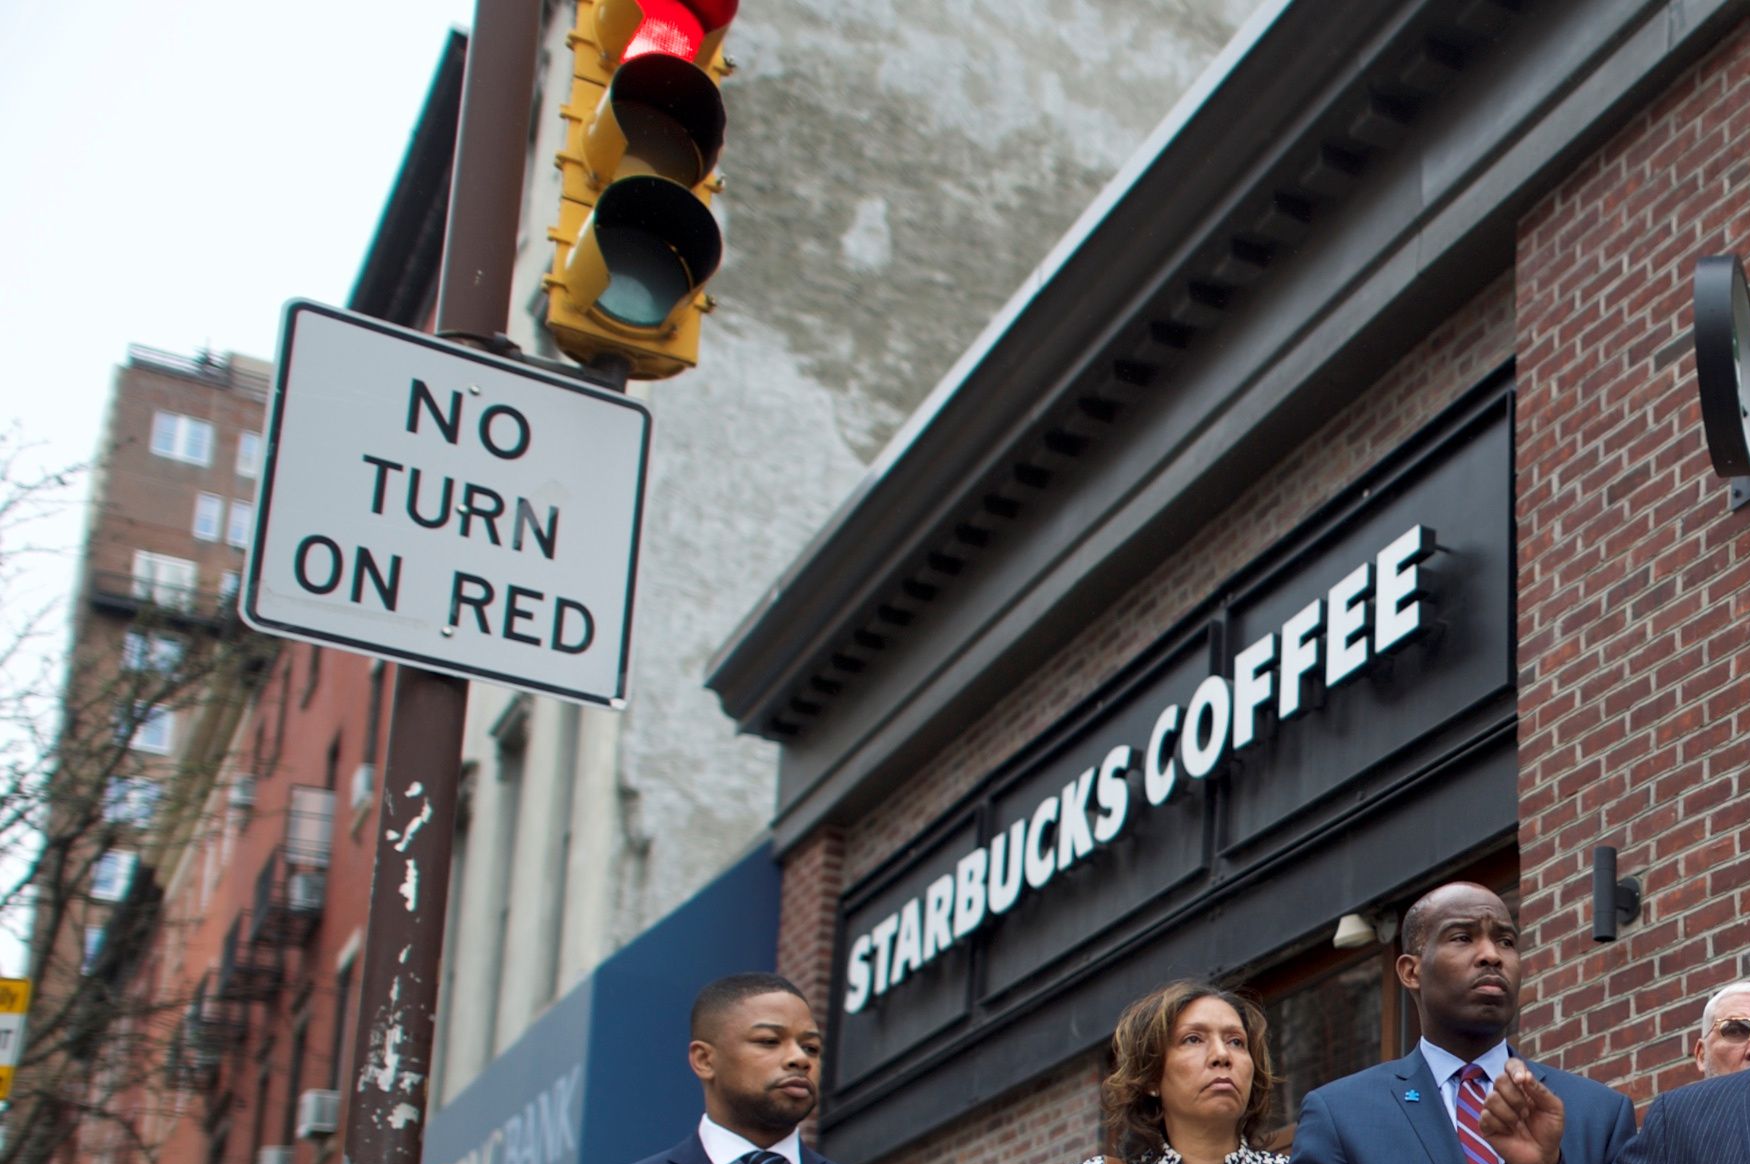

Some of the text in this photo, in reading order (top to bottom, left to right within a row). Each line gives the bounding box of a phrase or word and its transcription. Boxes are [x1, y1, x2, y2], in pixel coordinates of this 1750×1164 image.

[406, 379, 531, 460] NO
[363, 455, 560, 560] TURN
[294, 535, 596, 655] ON RED
[844, 524, 1423, 1014] STARBUCKS COFFEE
